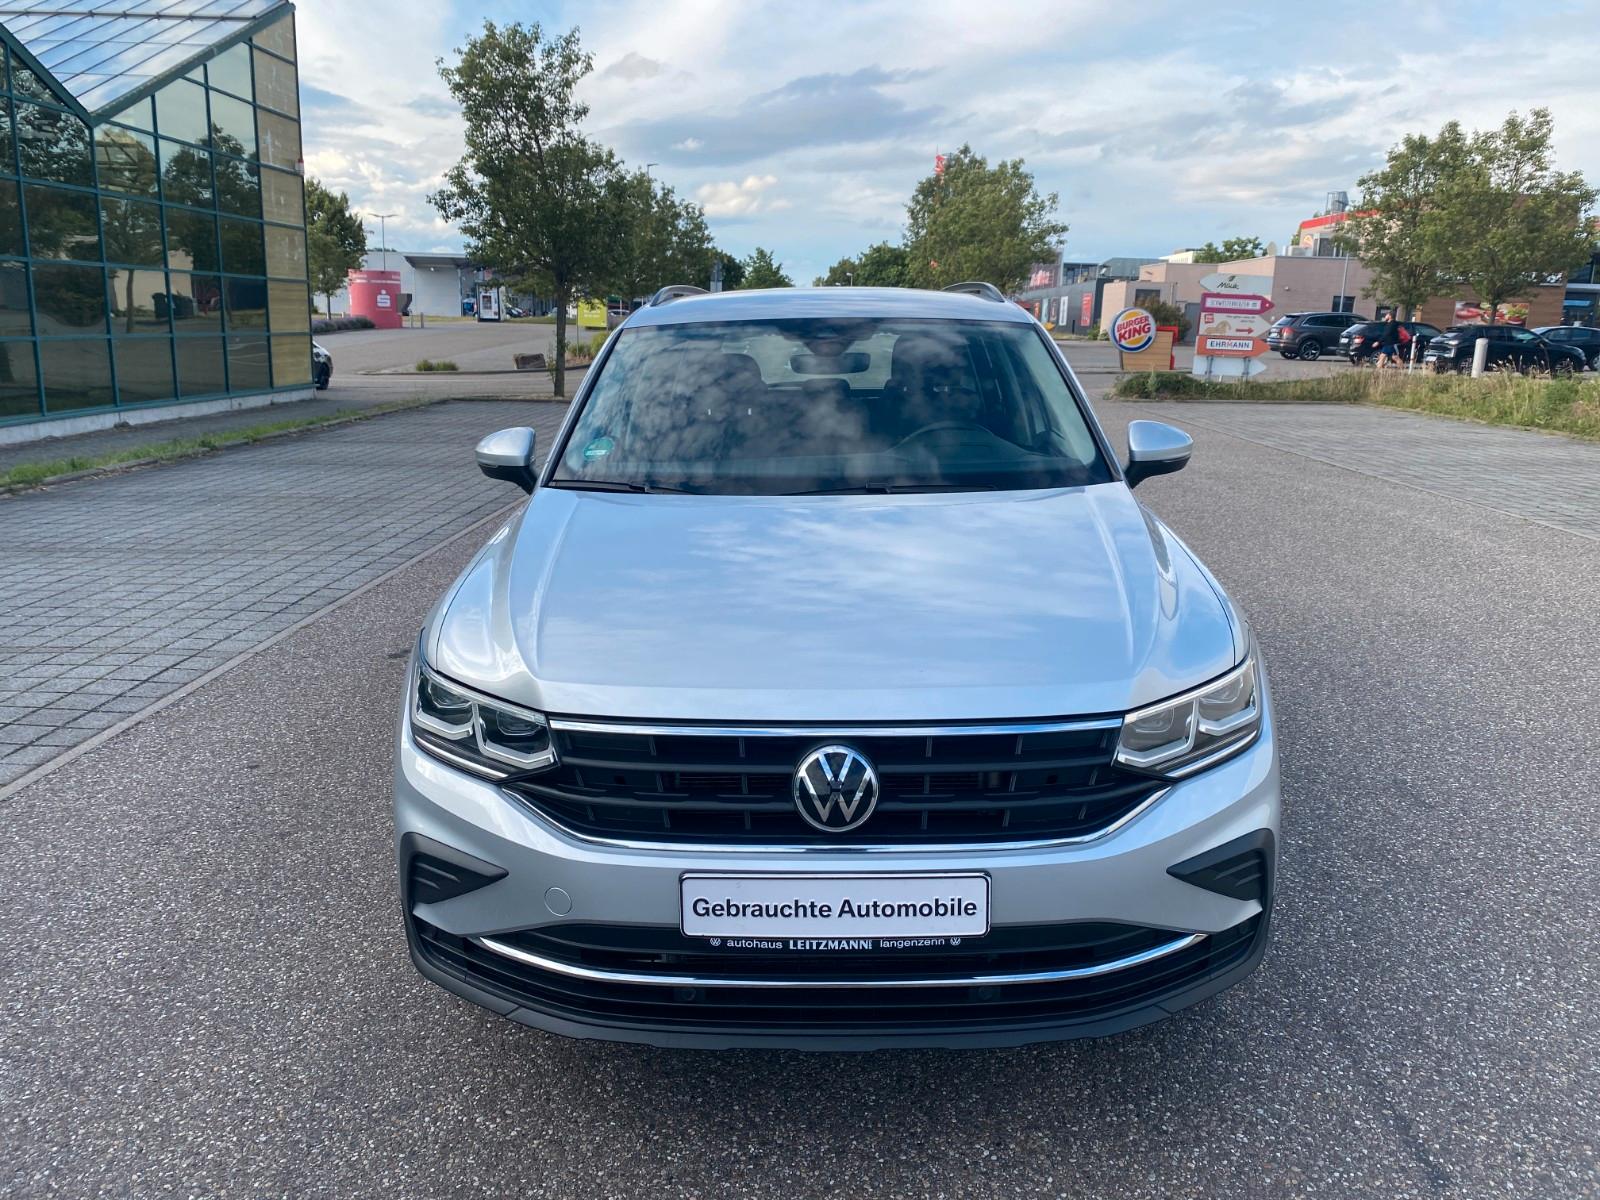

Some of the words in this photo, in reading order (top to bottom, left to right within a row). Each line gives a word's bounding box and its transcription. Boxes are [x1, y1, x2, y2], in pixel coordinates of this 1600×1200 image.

[1116, 315, 1149, 333] BURGER
[1118, 323, 1151, 343] KING
[1210, 340, 1250, 349] EHRMANN
[692, 897, 832, 919] Gebrauchte
[838, 897, 978, 919] Automobile
[726, 938, 783, 949] autohaus
[789, 939, 868, 951] LEITZMANN
[880, 937, 945, 949] langenzenn
